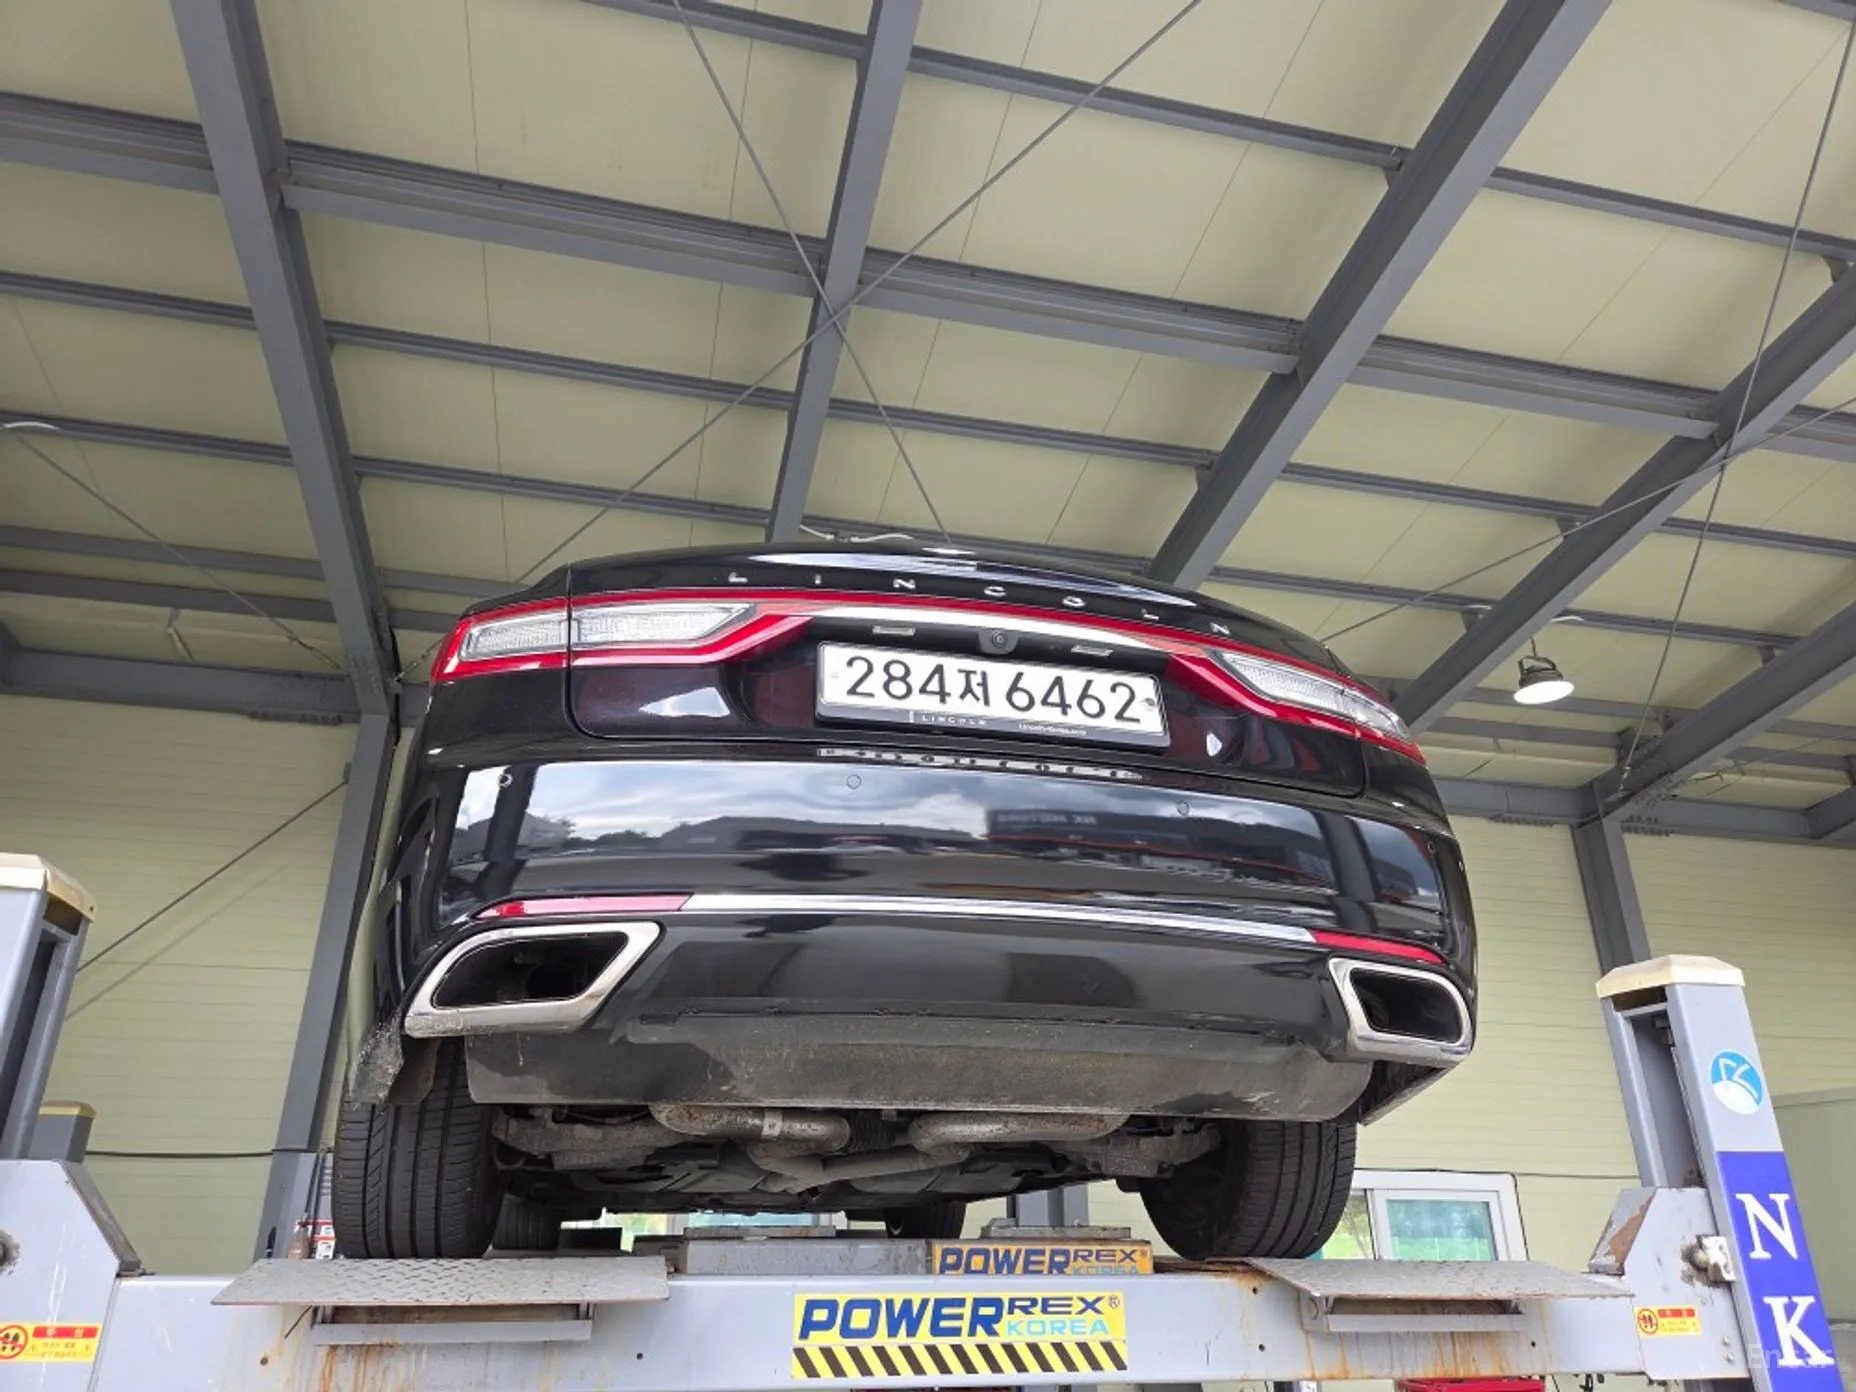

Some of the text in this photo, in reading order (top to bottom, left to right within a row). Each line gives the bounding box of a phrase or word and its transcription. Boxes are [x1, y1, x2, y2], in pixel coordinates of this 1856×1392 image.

[728, 571, 1231, 636] LINCOLN
[846, 655, 1141, 724] 284저 6462
[922, 714, 986, 726] LINCOLN
[939, 1247, 1072, 1275] POWER
[798, 1297, 1004, 1340] POWER
[1006, 1319, 1110, 1336] KOREA
